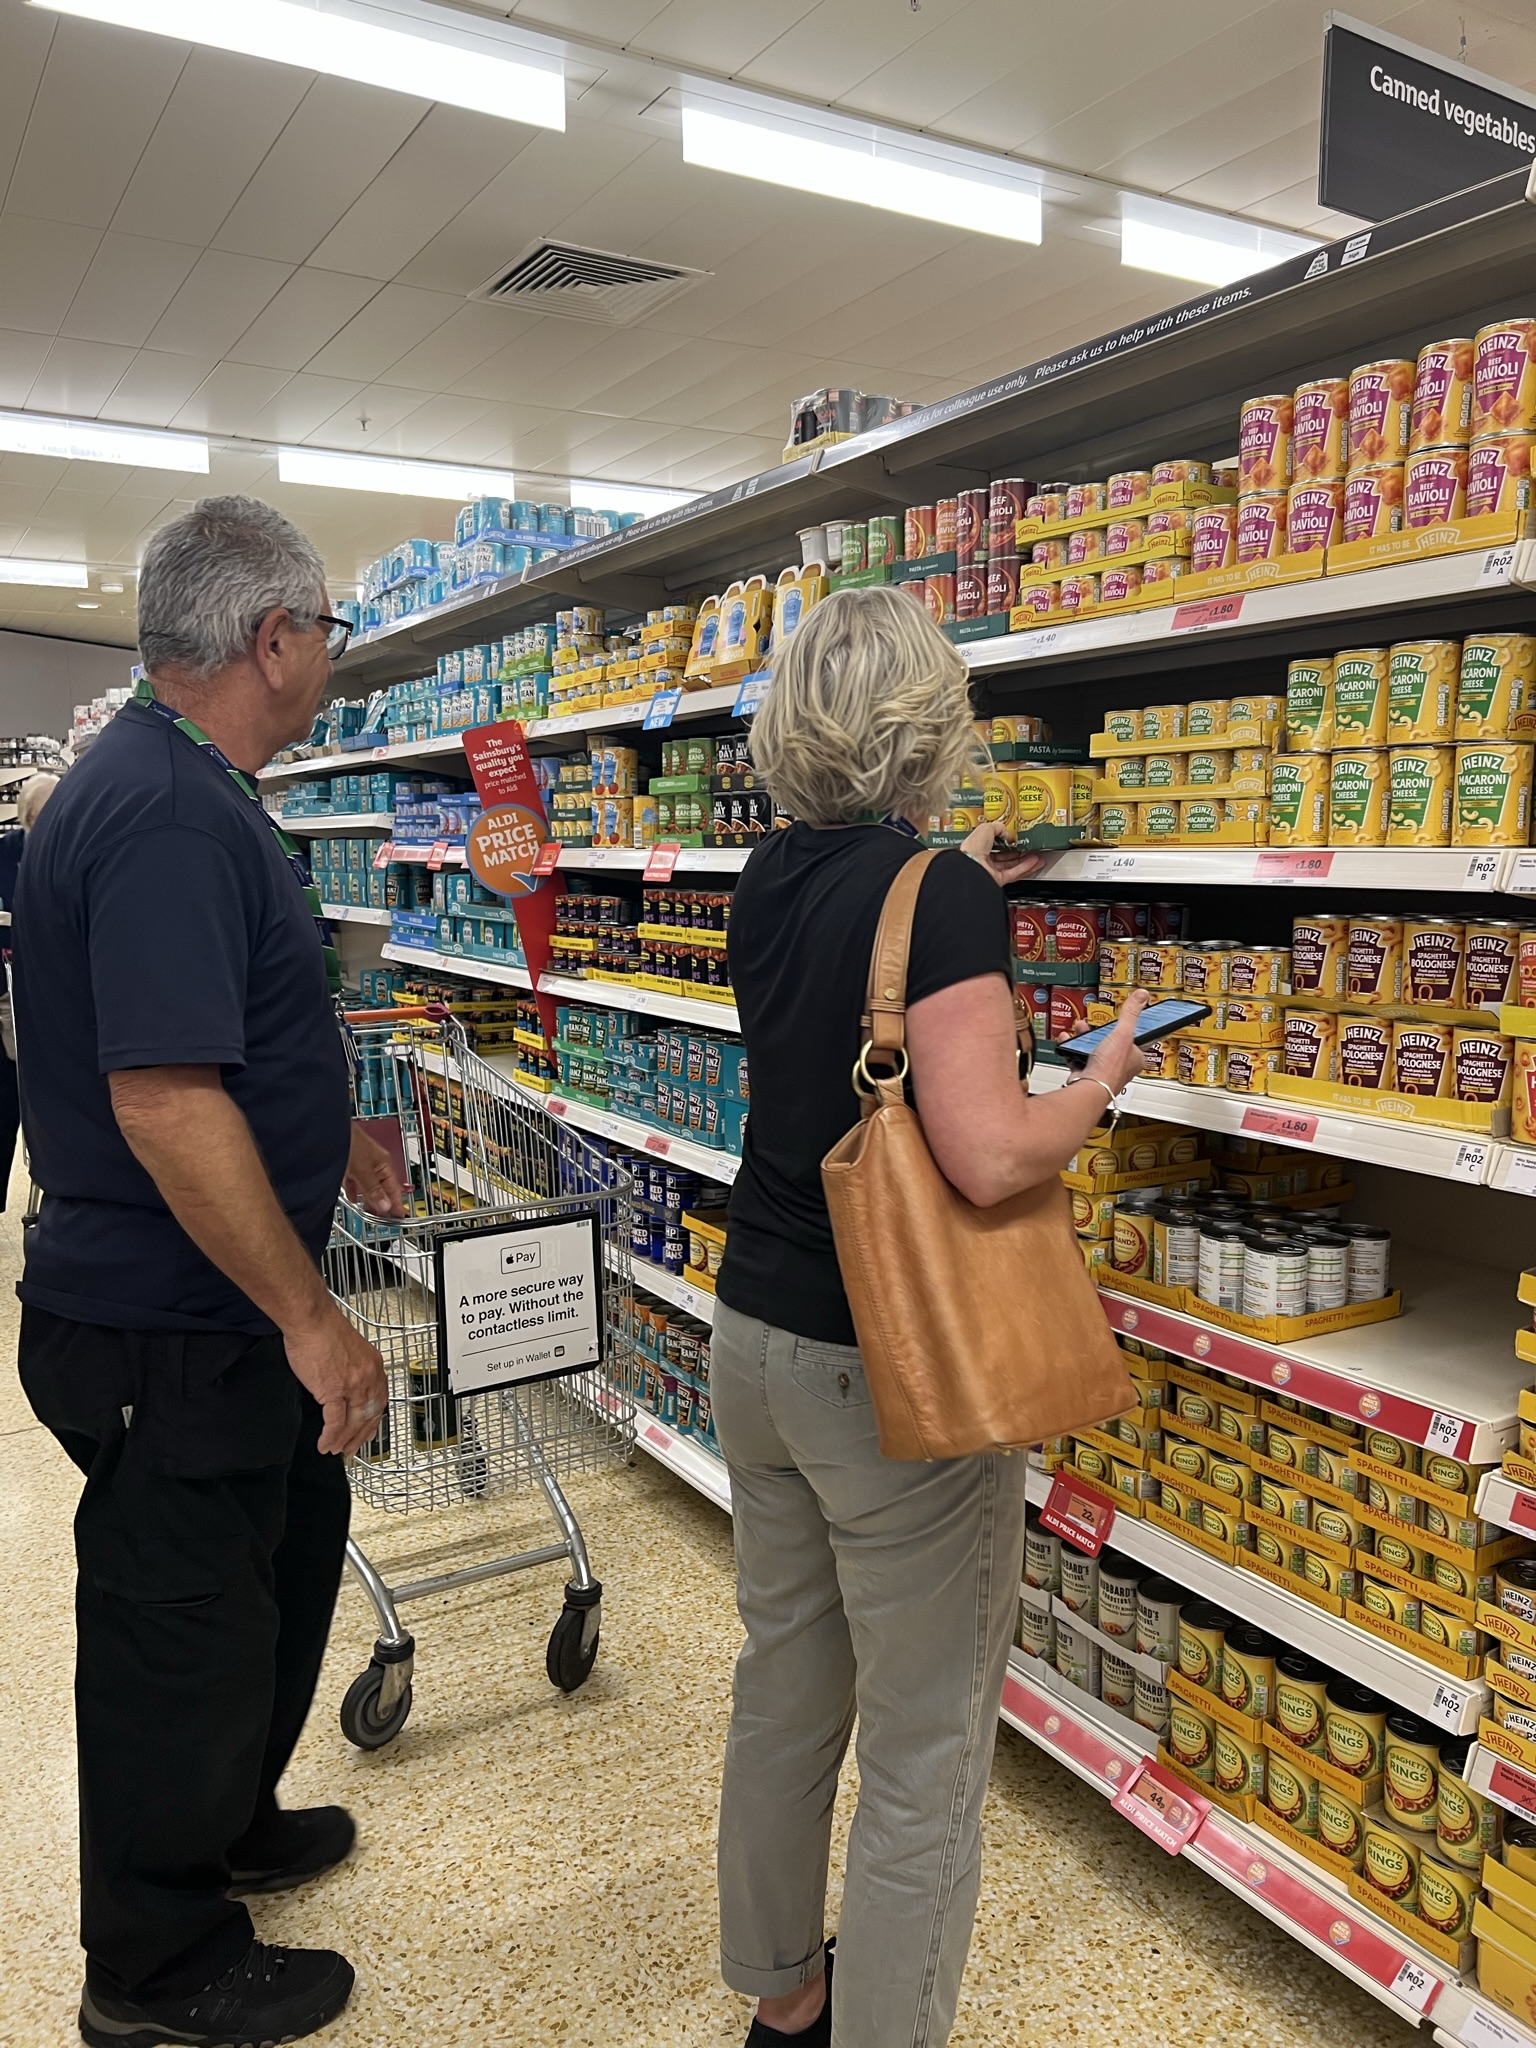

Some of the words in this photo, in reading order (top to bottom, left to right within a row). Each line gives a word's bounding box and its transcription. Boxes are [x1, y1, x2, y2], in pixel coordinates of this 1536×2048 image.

[1369, 65, 1441, 116] Canned
[1444, 99, 1536, 154] vegetables
[1479, 336, 1517, 357] HEINZ
[930, 408, 943, 423] for
[944, 391, 986, 414] colleague
[987, 384, 1003, 398] use
[1004, 373, 1028, 390] only.
[1034, 358, 1068, 379] Please
[1069, 349, 1087, 366] ask
[1090, 345, 1103, 358] us
[1105, 336, 1117, 351] to
[1118, 329, 1144, 348] help
[1147, 316, 1173, 337] with
[1176, 303, 1210, 325] these
[1212, 285, 1252, 311] items.
[1488, 356, 1502, 367] BEEF
[1477, 361, 1518, 381] RAVIOLI
[1350, 377, 1381, 396] HEINZ
[1295, 393, 1323, 413] HEINZ
[1243, 408, 1271, 426] HEINZ
[1350, 401, 1382, 420] RAVIOLI
[1248, 427, 1258, 435] BEEF
[1293, 418, 1325, 436] RAVIOLI
[1241, 432, 1272, 447] RAVIOLI
[1411, 461, 1449, 482] HEINZ
[1420, 481, 1434, 491] BEEF
[990, 496, 1007, 507] BEEF
[1294, 492, 1328, 508] HEINZ
[1408, 487, 1449, 506] RAVIOLI
[1301, 510, 1314, 519] BEEF
[1194, 517, 1222, 533] HEINZ
[1291, 516, 1328, 531] RAVIOLI
[1192, 539, 1223, 552] RAVIOLI
[1376, 543, 1390, 554] HAS
[1391, 541, 1400, 550] TO
[1402, 539, 1411, 548] BE
[1421, 529, 1457, 547] HEINZ
[1492, 556, 1513, 568] R02
[1496, 567, 1504, 575] A
[1209, 604, 1233, 616] £1.80
[1036, 633, 1056, 644] £1.40
[1463, 649, 1493, 662] HEINZ
[1338, 664, 1371, 676] HEINZ
[1335, 680, 1376, 693] MACARONI
[1462, 679, 1484, 688] CHEESE
[1340, 691, 1364, 701] CHEESE
[741, 702, 759, 713] NEW
[649, 717, 666, 728] NEW
[486, 739, 503, 748] The
[1029, 746, 1051, 754] PASTA
[472, 744, 521, 762] Sainsbury's
[719, 749, 734, 758] DAY
[476, 758, 507, 772] quality
[507, 753, 524, 766] you
[1121, 763, 1143, 771] HEINZ
[1334, 762, 1365, 776] HEINZ
[1391, 760, 1425, 773] HEINZ
[1463, 756, 1502, 770] HEINZ
[488, 765, 517, 778] expect
[484, 779, 500, 790] price
[500, 772, 527, 785] matched
[1458, 774, 1506, 786] MACARONI
[506, 785, 518, 794] Aldi
[1335, 790, 1358, 799] CHEESE
[1392, 788, 1418, 798] CHEESE
[1465, 786, 1493, 795] CHEESE
[1150, 807, 1173, 816] HEINZ
[487, 812, 519, 831] ALDI
[1148, 817, 1175, 825] MACARONI
[476, 824, 537, 853] PRICE
[483, 841, 540, 868] MATCH
[1113, 858, 1135, 867] £1.40
[1295, 859, 1322, 870] £1.80
[1476, 863, 1496, 873] R02
[1480, 873, 1487, 881] B
[1056, 922, 1087, 933] SPAGHETTI
[1056, 931, 1087, 939] BOLOGNESE
[1416, 934, 1455, 949] HEINZ
[1469, 938, 1506, 953] HEINZ
[1417, 951, 1449, 960] SPAGHETTI
[1471, 956, 1501, 964] SPAGHETTI
[1411, 958, 1456, 970] BOLOGNESE
[1467, 962, 1509, 974] BOLOGNESE
[1347, 1027, 1382, 1041] HEINZ
[1347, 1043, 1377, 1052] SPAGHETTI
[1460, 1042, 1500, 1057] HEINZ
[1342, 1049, 1384, 1061] BOLOGNESE
[1462, 1060, 1494, 1068] SPAGHETTI
[1457, 1066, 1503, 1078] BOLOGNESE
[1281, 1120, 1308, 1132] £1.80
[1464, 1152, 1484, 1165] R02
[1468, 1163, 1475, 1172] C
[665, 1226, 677, 1237] HP
[515, 1252, 536, 1264] Pay
[459, 1296, 470, 1308] A
[472, 1289, 508, 1305] more
[511, 1279, 556, 1298] secure
[558, 1274, 584, 1288] way
[461, 1312, 475, 1325] to
[479, 1306, 506, 1324] pay.
[508, 1294, 560, 1314] Without
[563, 1290, 584, 1304] the
[1192, 1300, 1232, 1324] SPAGHETTI
[468, 1313, 545, 1341] contactless
[548, 1307, 579, 1324] limit.
[486, 1362, 502, 1372] Set
[503, 1359, 515, 1369] up
[516, 1357, 524, 1365] in
[525, 1350, 551, 1363] Wallet
[1438, 1423, 1458, 1438] R02
[1442, 1435, 1449, 1444] D
[1433, 1465, 1460, 1479] RINGS
[1356, 1457, 1408, 1487] SPAGHETTI
[1409, 1481, 1417, 1491] by
[1418, 1485, 1454, 1507] Sainsbury's
[1081, 1509, 1095, 1523] 22p
[1045, 1514, 1059, 1528] ALDI
[1059, 1523, 1076, 1538] PRICE
[1076, 1534, 1096, 1551] MATCH
[1320, 1522, 1344, 1534] RINGS
[1364, 1560, 1418, 1592] SPAGHETTI
[1420, 1587, 1428, 1597] by
[1428, 1592, 1466, 1615] Sainsbury's
[1505, 1591, 1531, 1606] HEINZ
[1502, 1602, 1533, 1619] HOOPS
[1488, 1616, 1517, 1638] HEINZ
[1280, 1700, 1313, 1719] RINGS
[1441, 1696, 1460, 1713] R02
[1445, 1710, 1451, 1718] E
[1389, 1752, 1429, 1773] SPAGHETTI
[1389, 1762, 1428, 1783] RINGS
[1150, 1792, 1166, 1809] 44p
[1118, 1797, 1136, 1815] ALDI
[1134, 1811, 1155, 1831] PRICE
[1153, 1826, 1177, 1848] MATCH
[1367, 1849, 1403, 1871] RINGS
[1420, 1881, 1452, 1906] RINGS
[1406, 1971, 1425, 1989] R02
[1408, 1985, 1415, 1993] F
